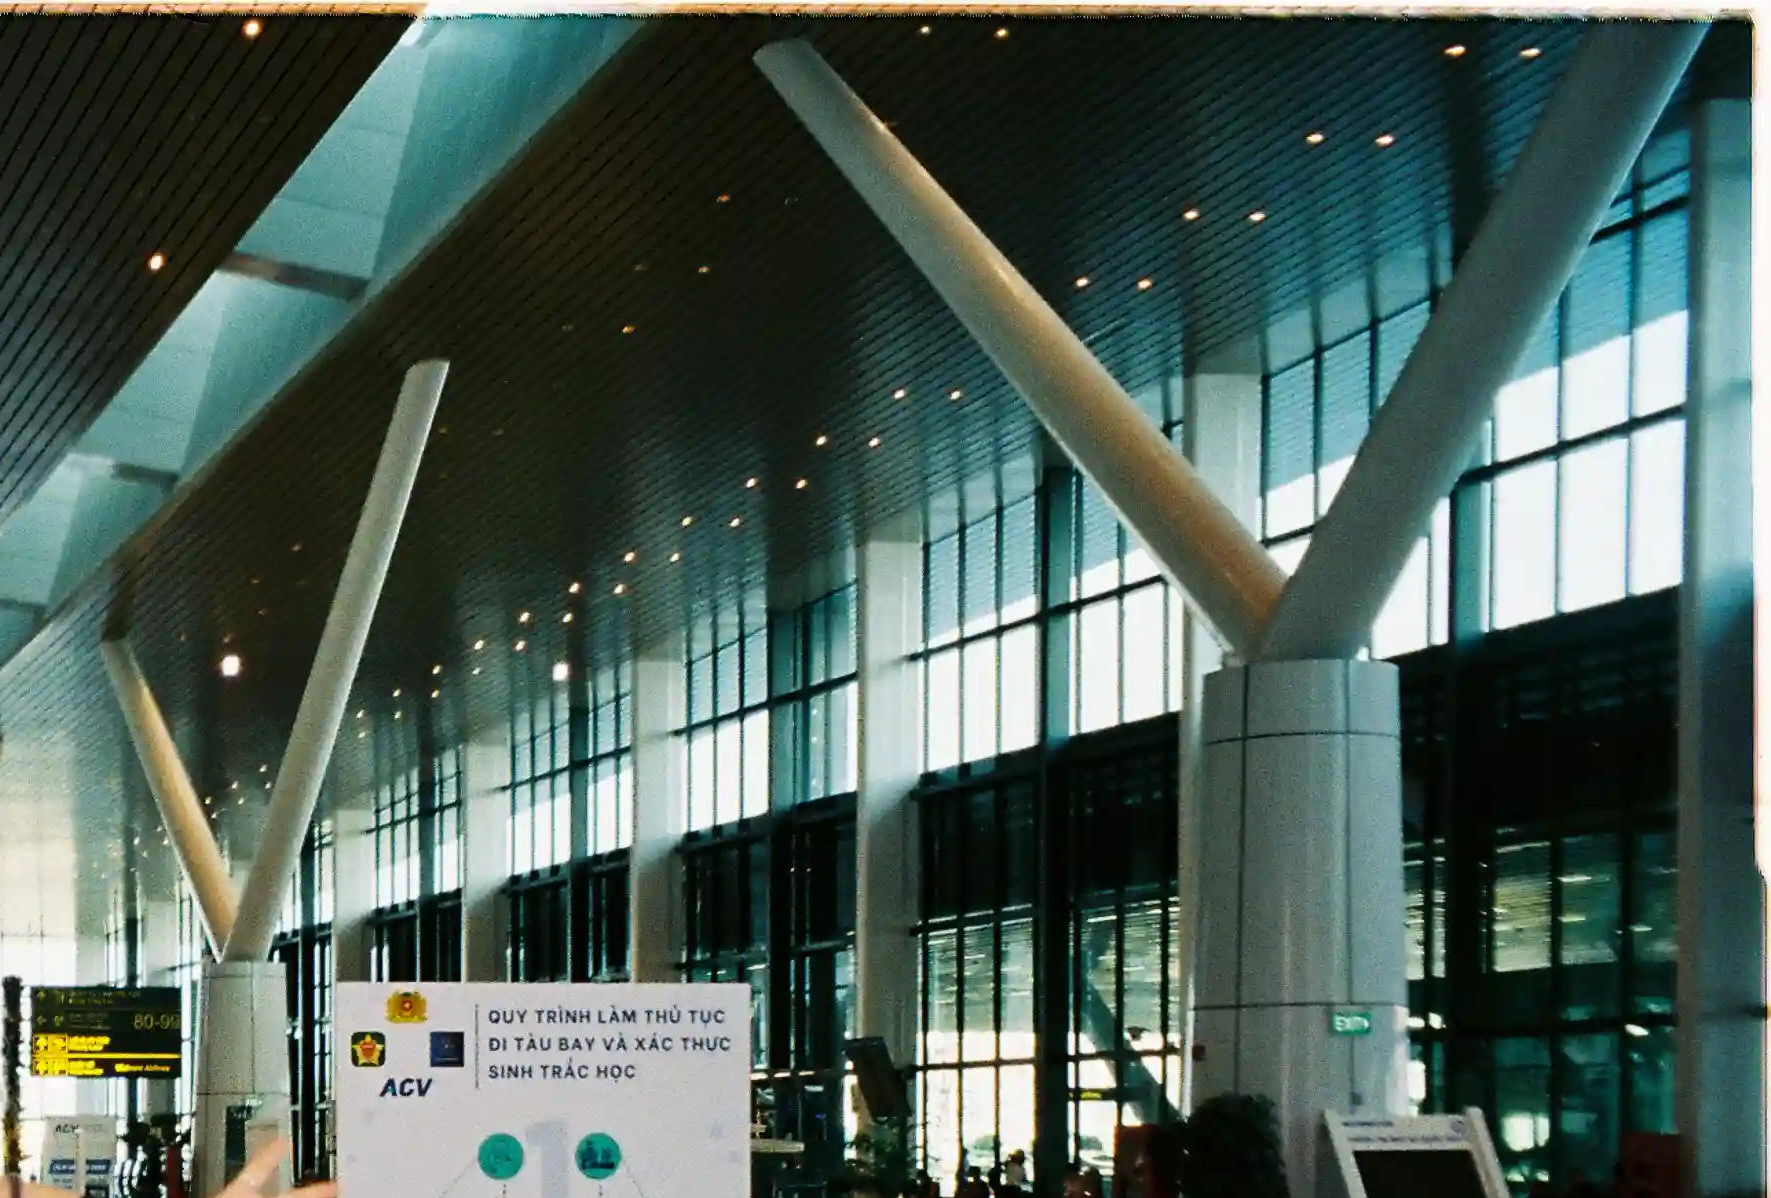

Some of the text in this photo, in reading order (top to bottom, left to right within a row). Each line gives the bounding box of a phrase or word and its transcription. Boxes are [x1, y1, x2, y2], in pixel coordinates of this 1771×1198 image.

[488, 1004, 726, 1028] QUY TRÌNH LÀM THỦ TỤC
[488, 1037, 507, 1052] ĐI
[514, 1032, 552, 1052] TÀU
[559, 1037, 595, 1052] BAY
[602, 1032, 628, 1052] VÀ
[634, 1032, 674, 1052] XÁC
[488, 1065, 533, 1079] SINH
[596, 1065, 637, 1083] HỌC
[379, 1078, 433, 1097] ACV
